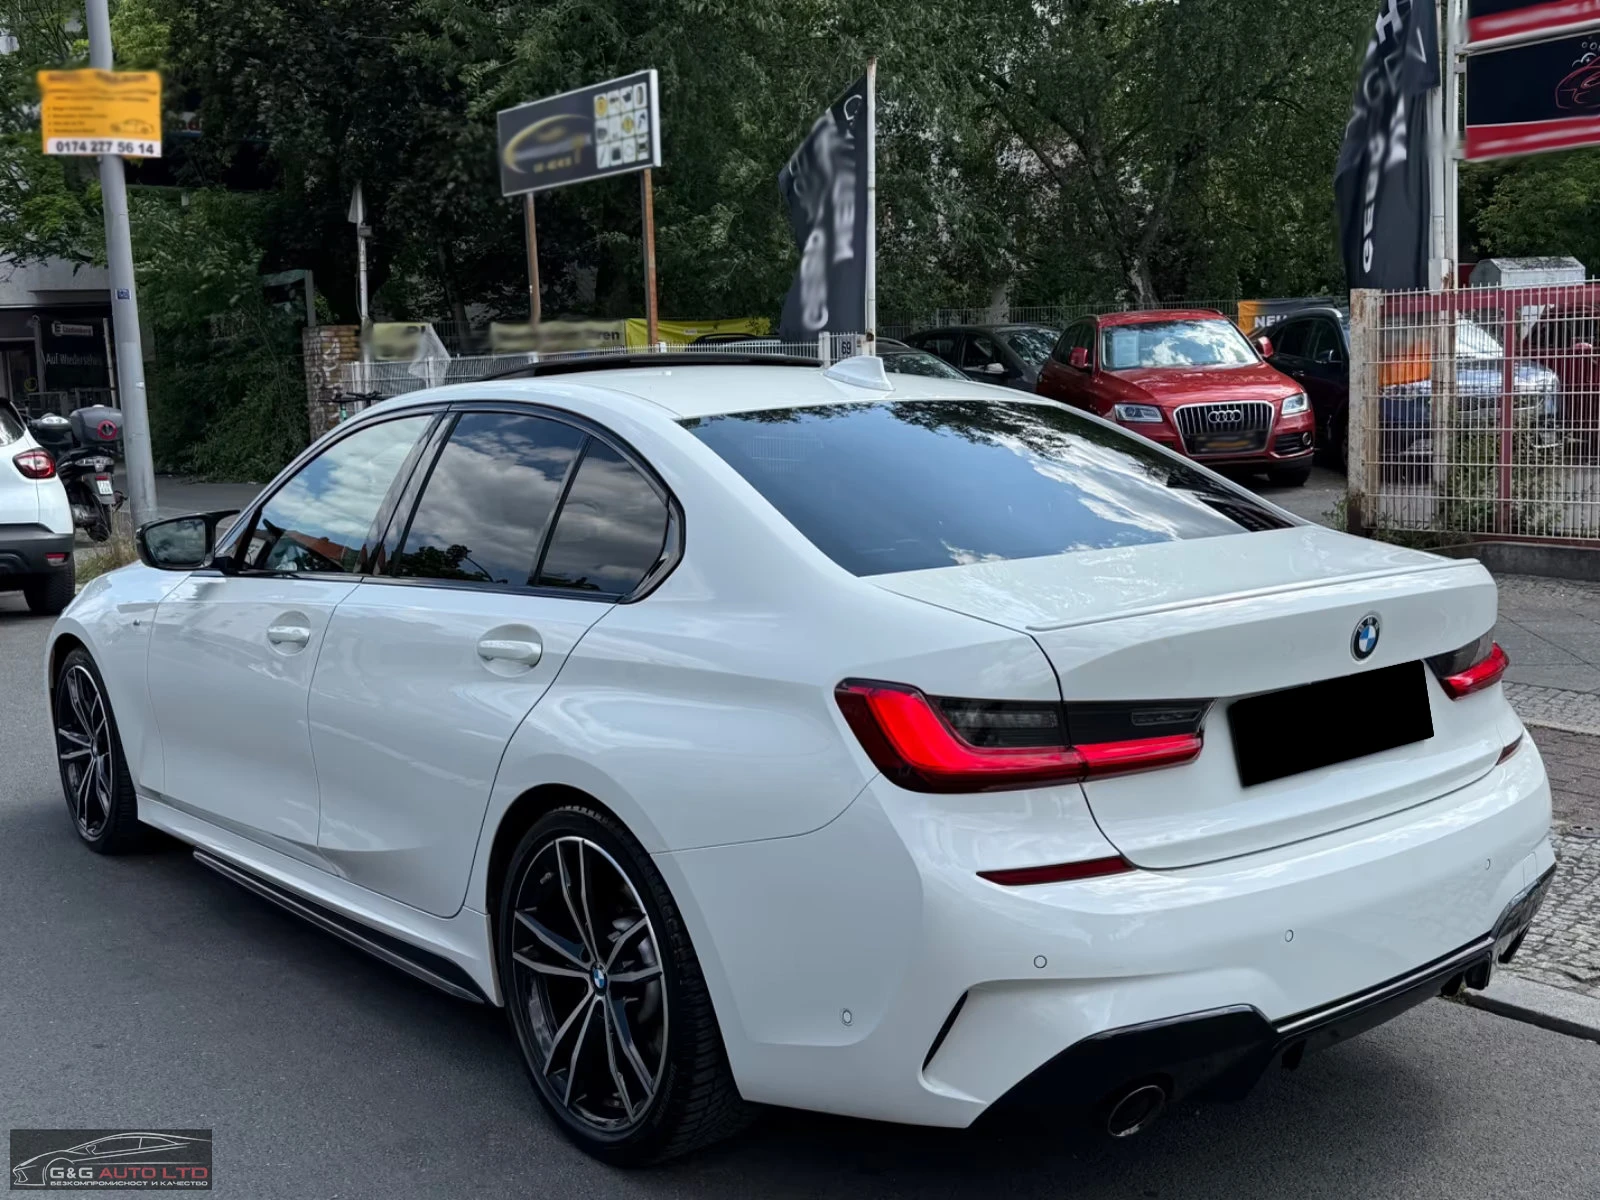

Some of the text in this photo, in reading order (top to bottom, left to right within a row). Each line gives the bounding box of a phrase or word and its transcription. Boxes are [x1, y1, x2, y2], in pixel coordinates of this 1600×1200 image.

[56, 140, 154, 155] 0174 227 56 14
[841, 341, 852, 355] 69
[46, 353, 59, 365] Auf
